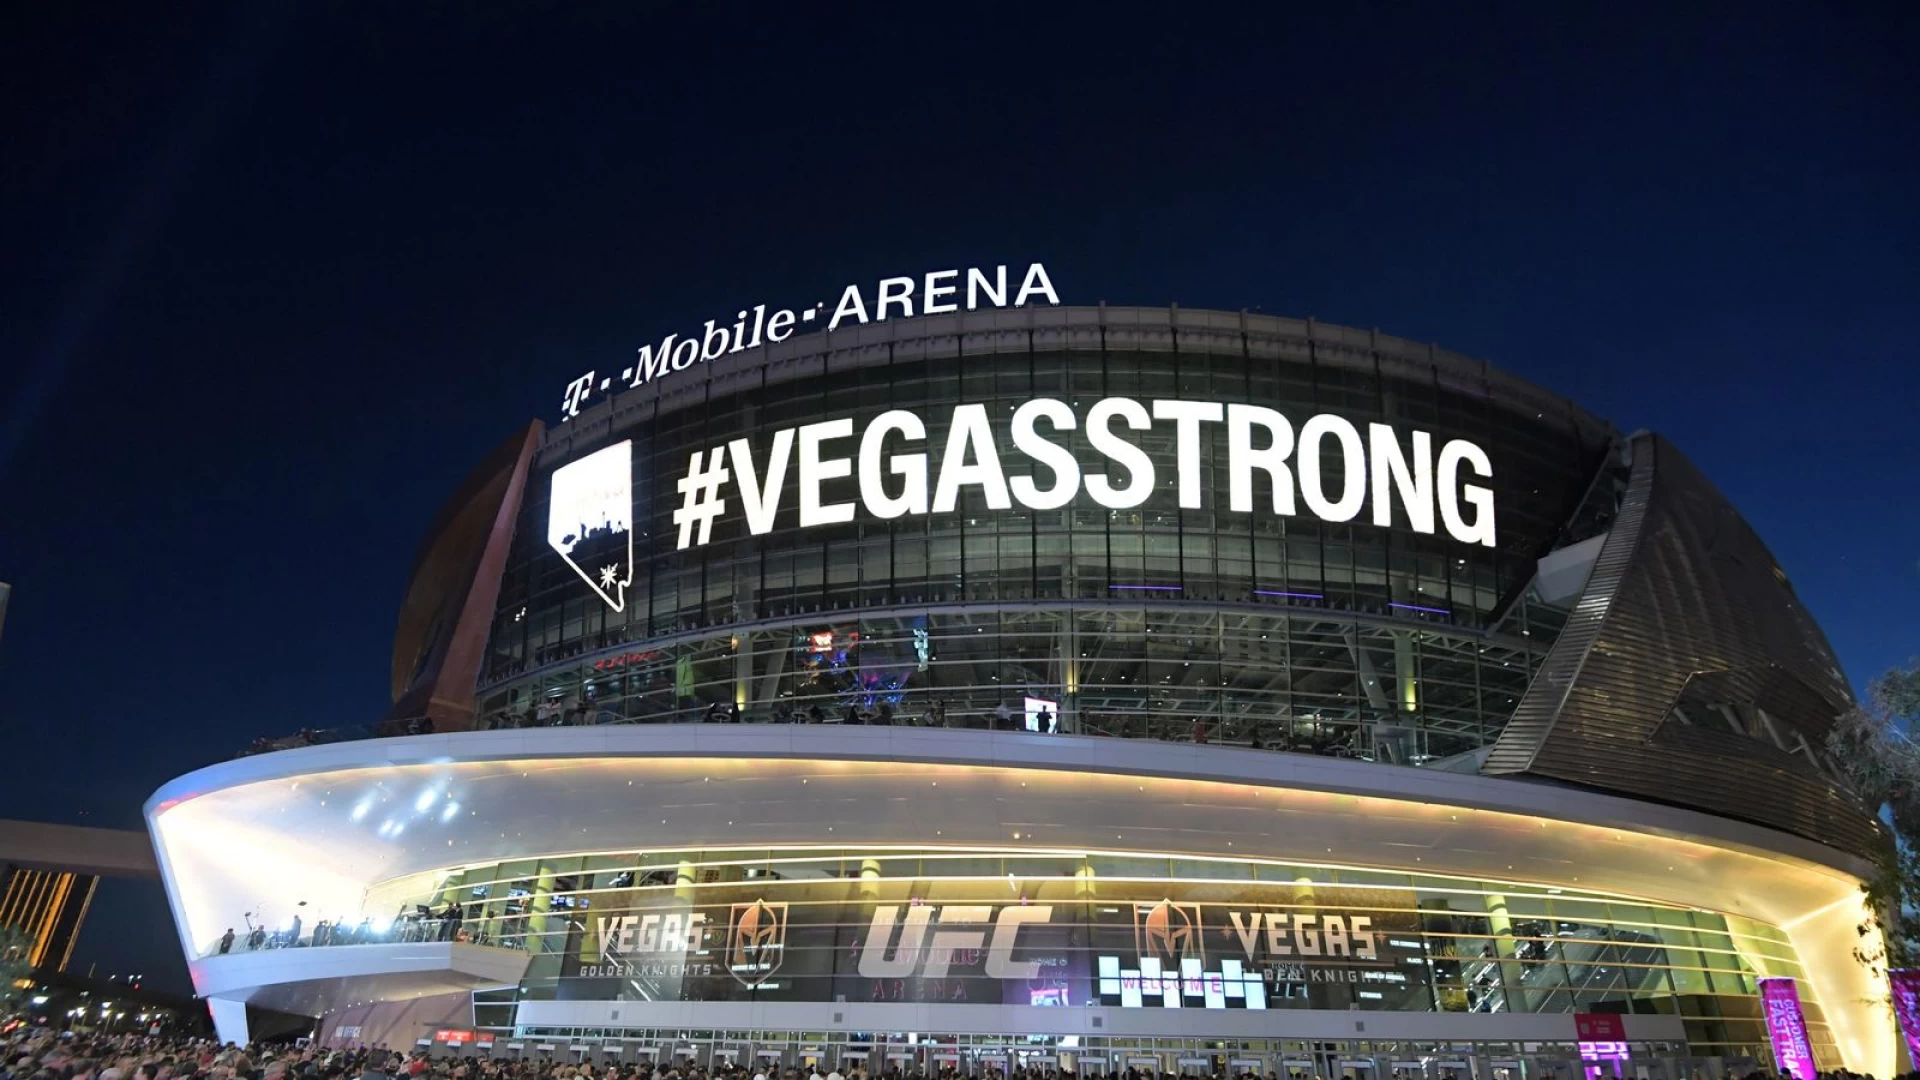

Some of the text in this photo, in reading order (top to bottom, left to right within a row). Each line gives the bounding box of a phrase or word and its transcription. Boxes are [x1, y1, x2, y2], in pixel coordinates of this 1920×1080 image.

[827, 263, 1060, 331] ARENA
[673, 397, 1496, 550] #VEGASSTRONG
[597, 913, 706, 961] VEGAS
[858, 905, 1053, 978] UFC
[1229, 911, 1377, 963] VEGAS
[580, 963, 712, 977] GOLDEN KNIGHTS
[1311, 970, 1397, 984] KNIGH
[1768, 999, 1790, 1036] FAST
